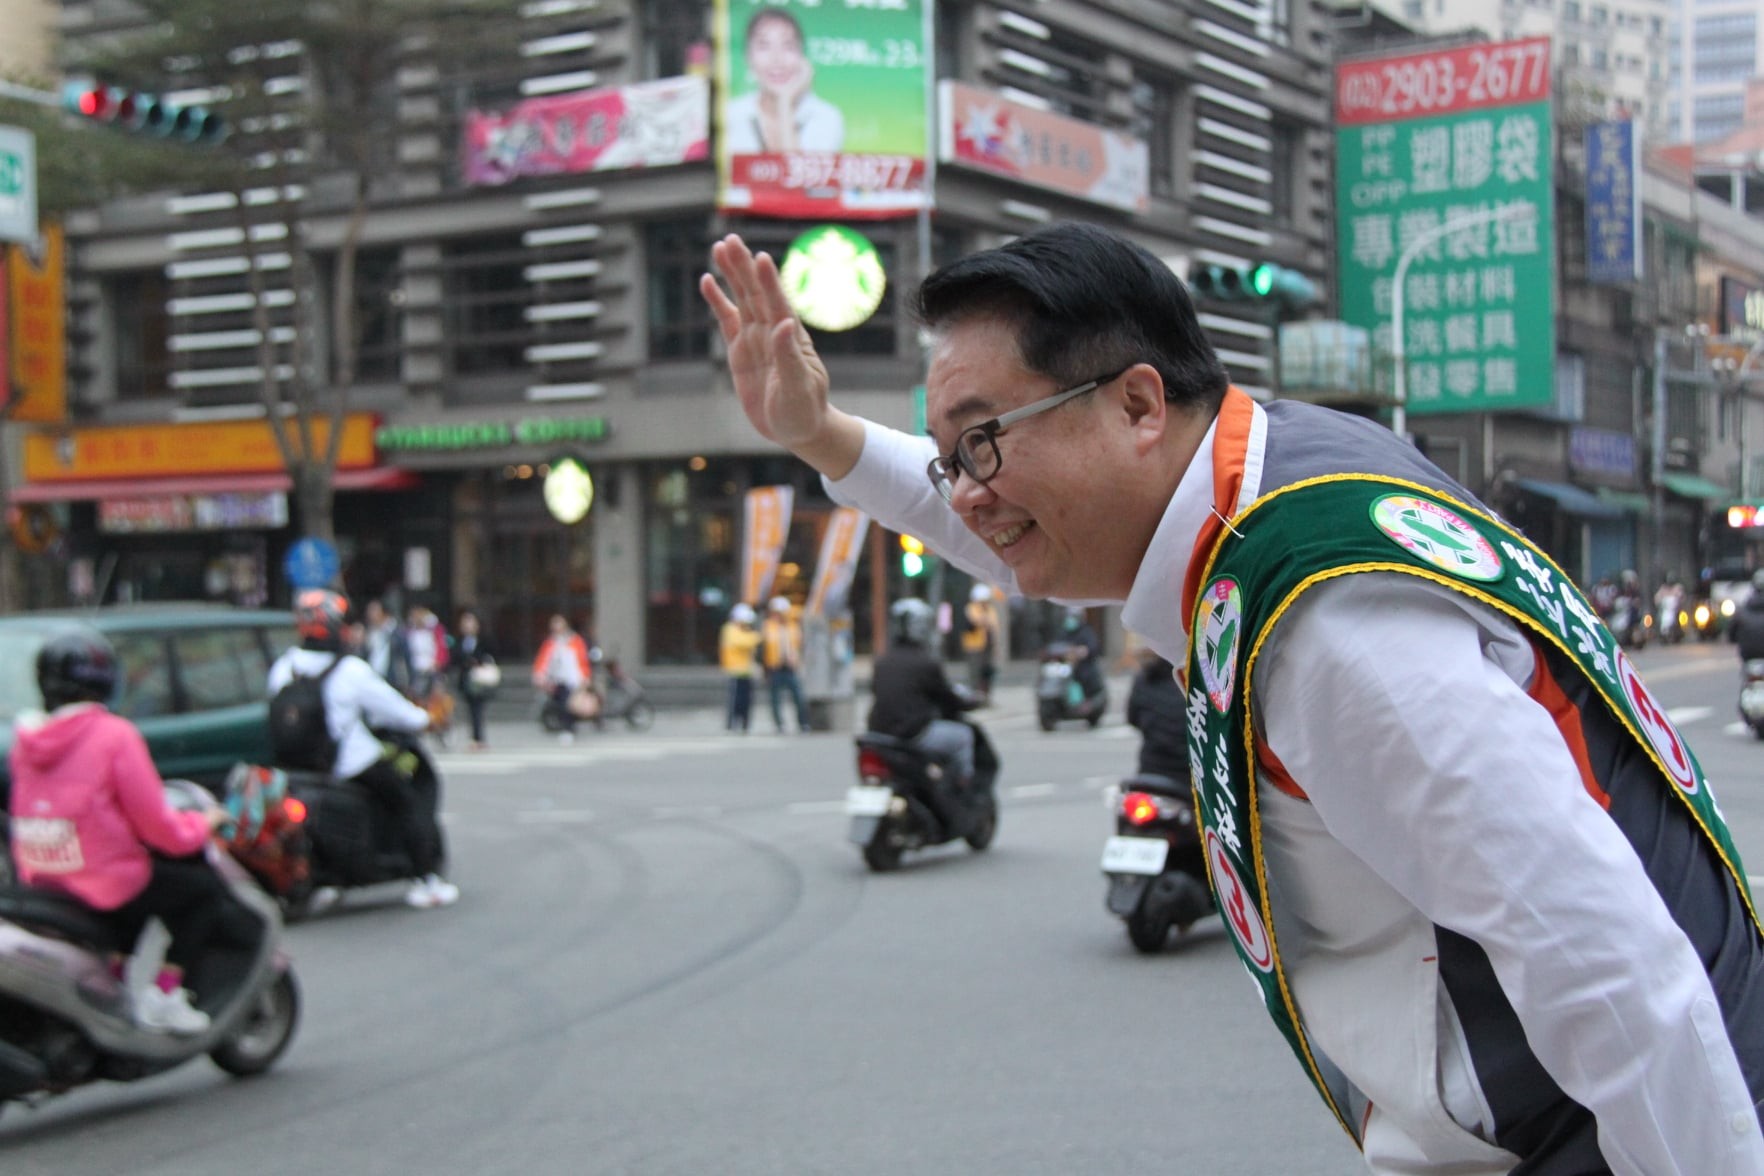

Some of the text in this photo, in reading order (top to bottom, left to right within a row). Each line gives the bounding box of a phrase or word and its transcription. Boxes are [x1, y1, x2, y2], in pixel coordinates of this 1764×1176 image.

[1410, 114, 1539, 194] 塑膠袋
[1351, 179, 1407, 209] OPP
[1351, 197, 1541, 269] 專業製造
[1629, 673, 1686, 770] 3
